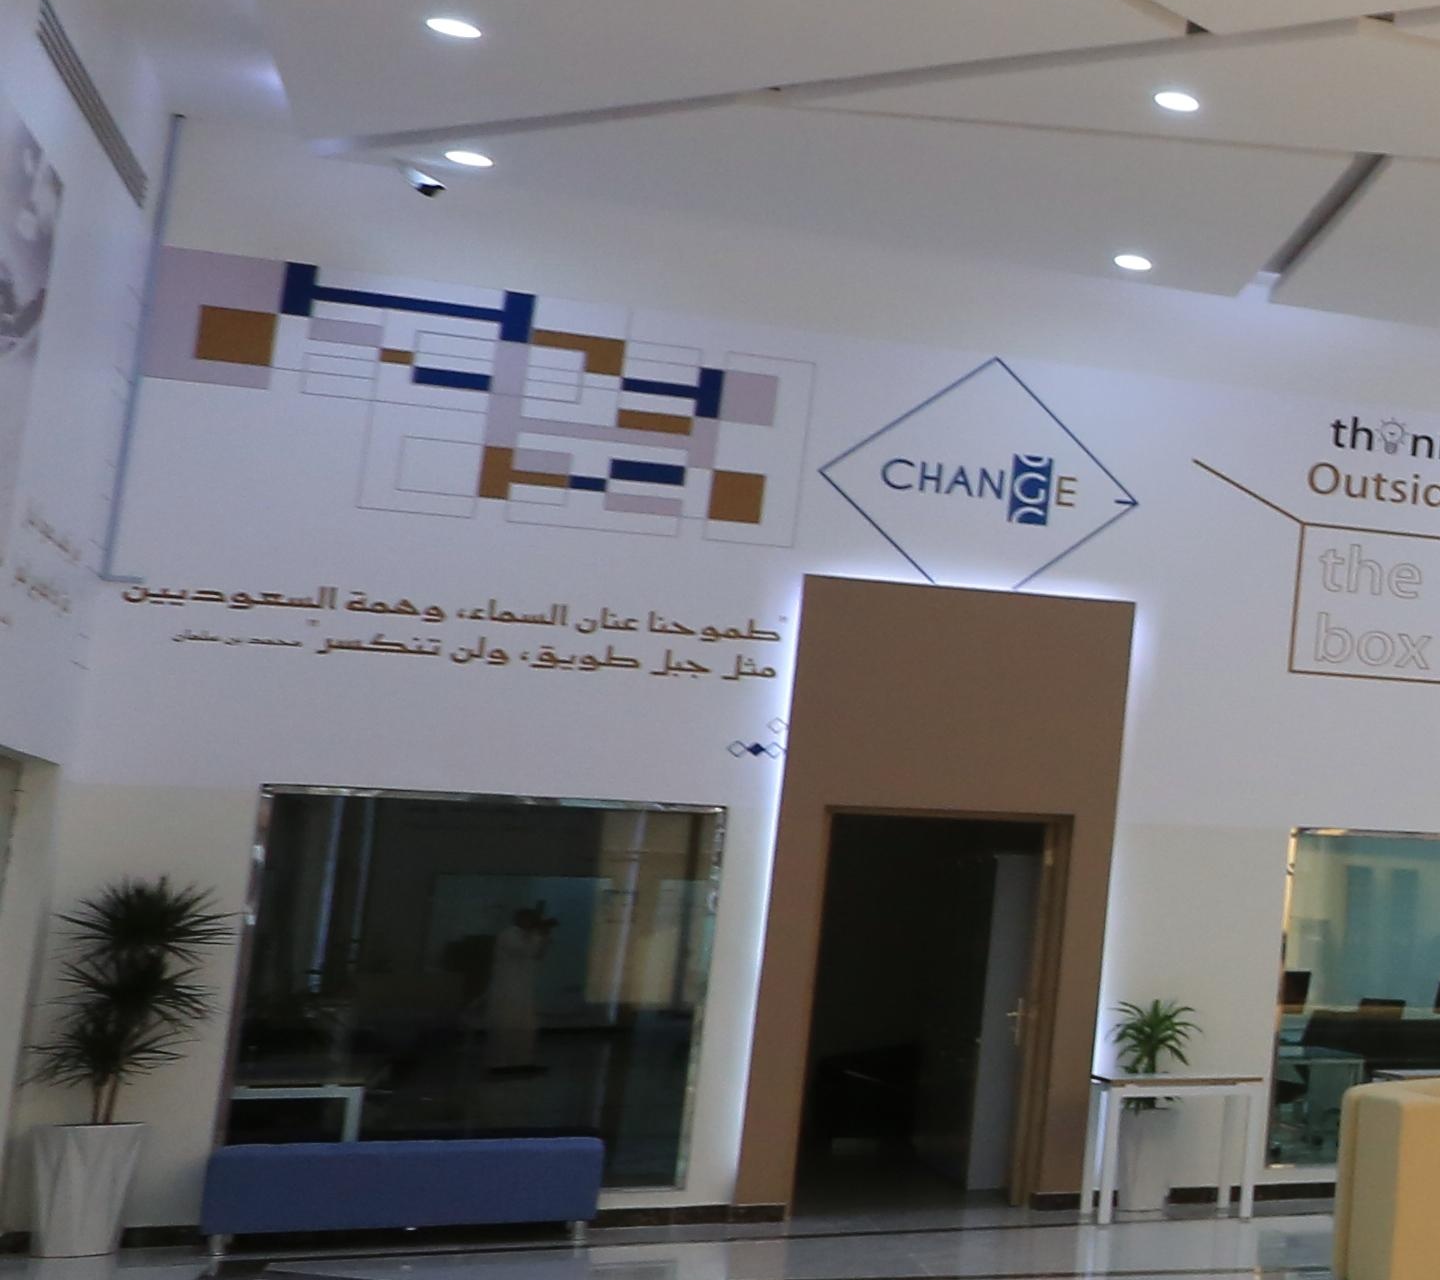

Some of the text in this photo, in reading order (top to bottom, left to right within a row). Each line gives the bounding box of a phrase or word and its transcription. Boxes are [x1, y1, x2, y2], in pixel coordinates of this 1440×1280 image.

[881, 456, 1078, 512] CHANGE
[1318, 544, 1422, 599] the
[122, 586, 338, 611] السعوديين
[345, 590, 447, 622] وهمة
[575, 606, 639, 634] عنان
[450, 636, 509, 664] ولن
[1313, 611, 1433, 670] box
[649, 649, 711, 678] جبل
[721, 653, 777, 680] مثل
